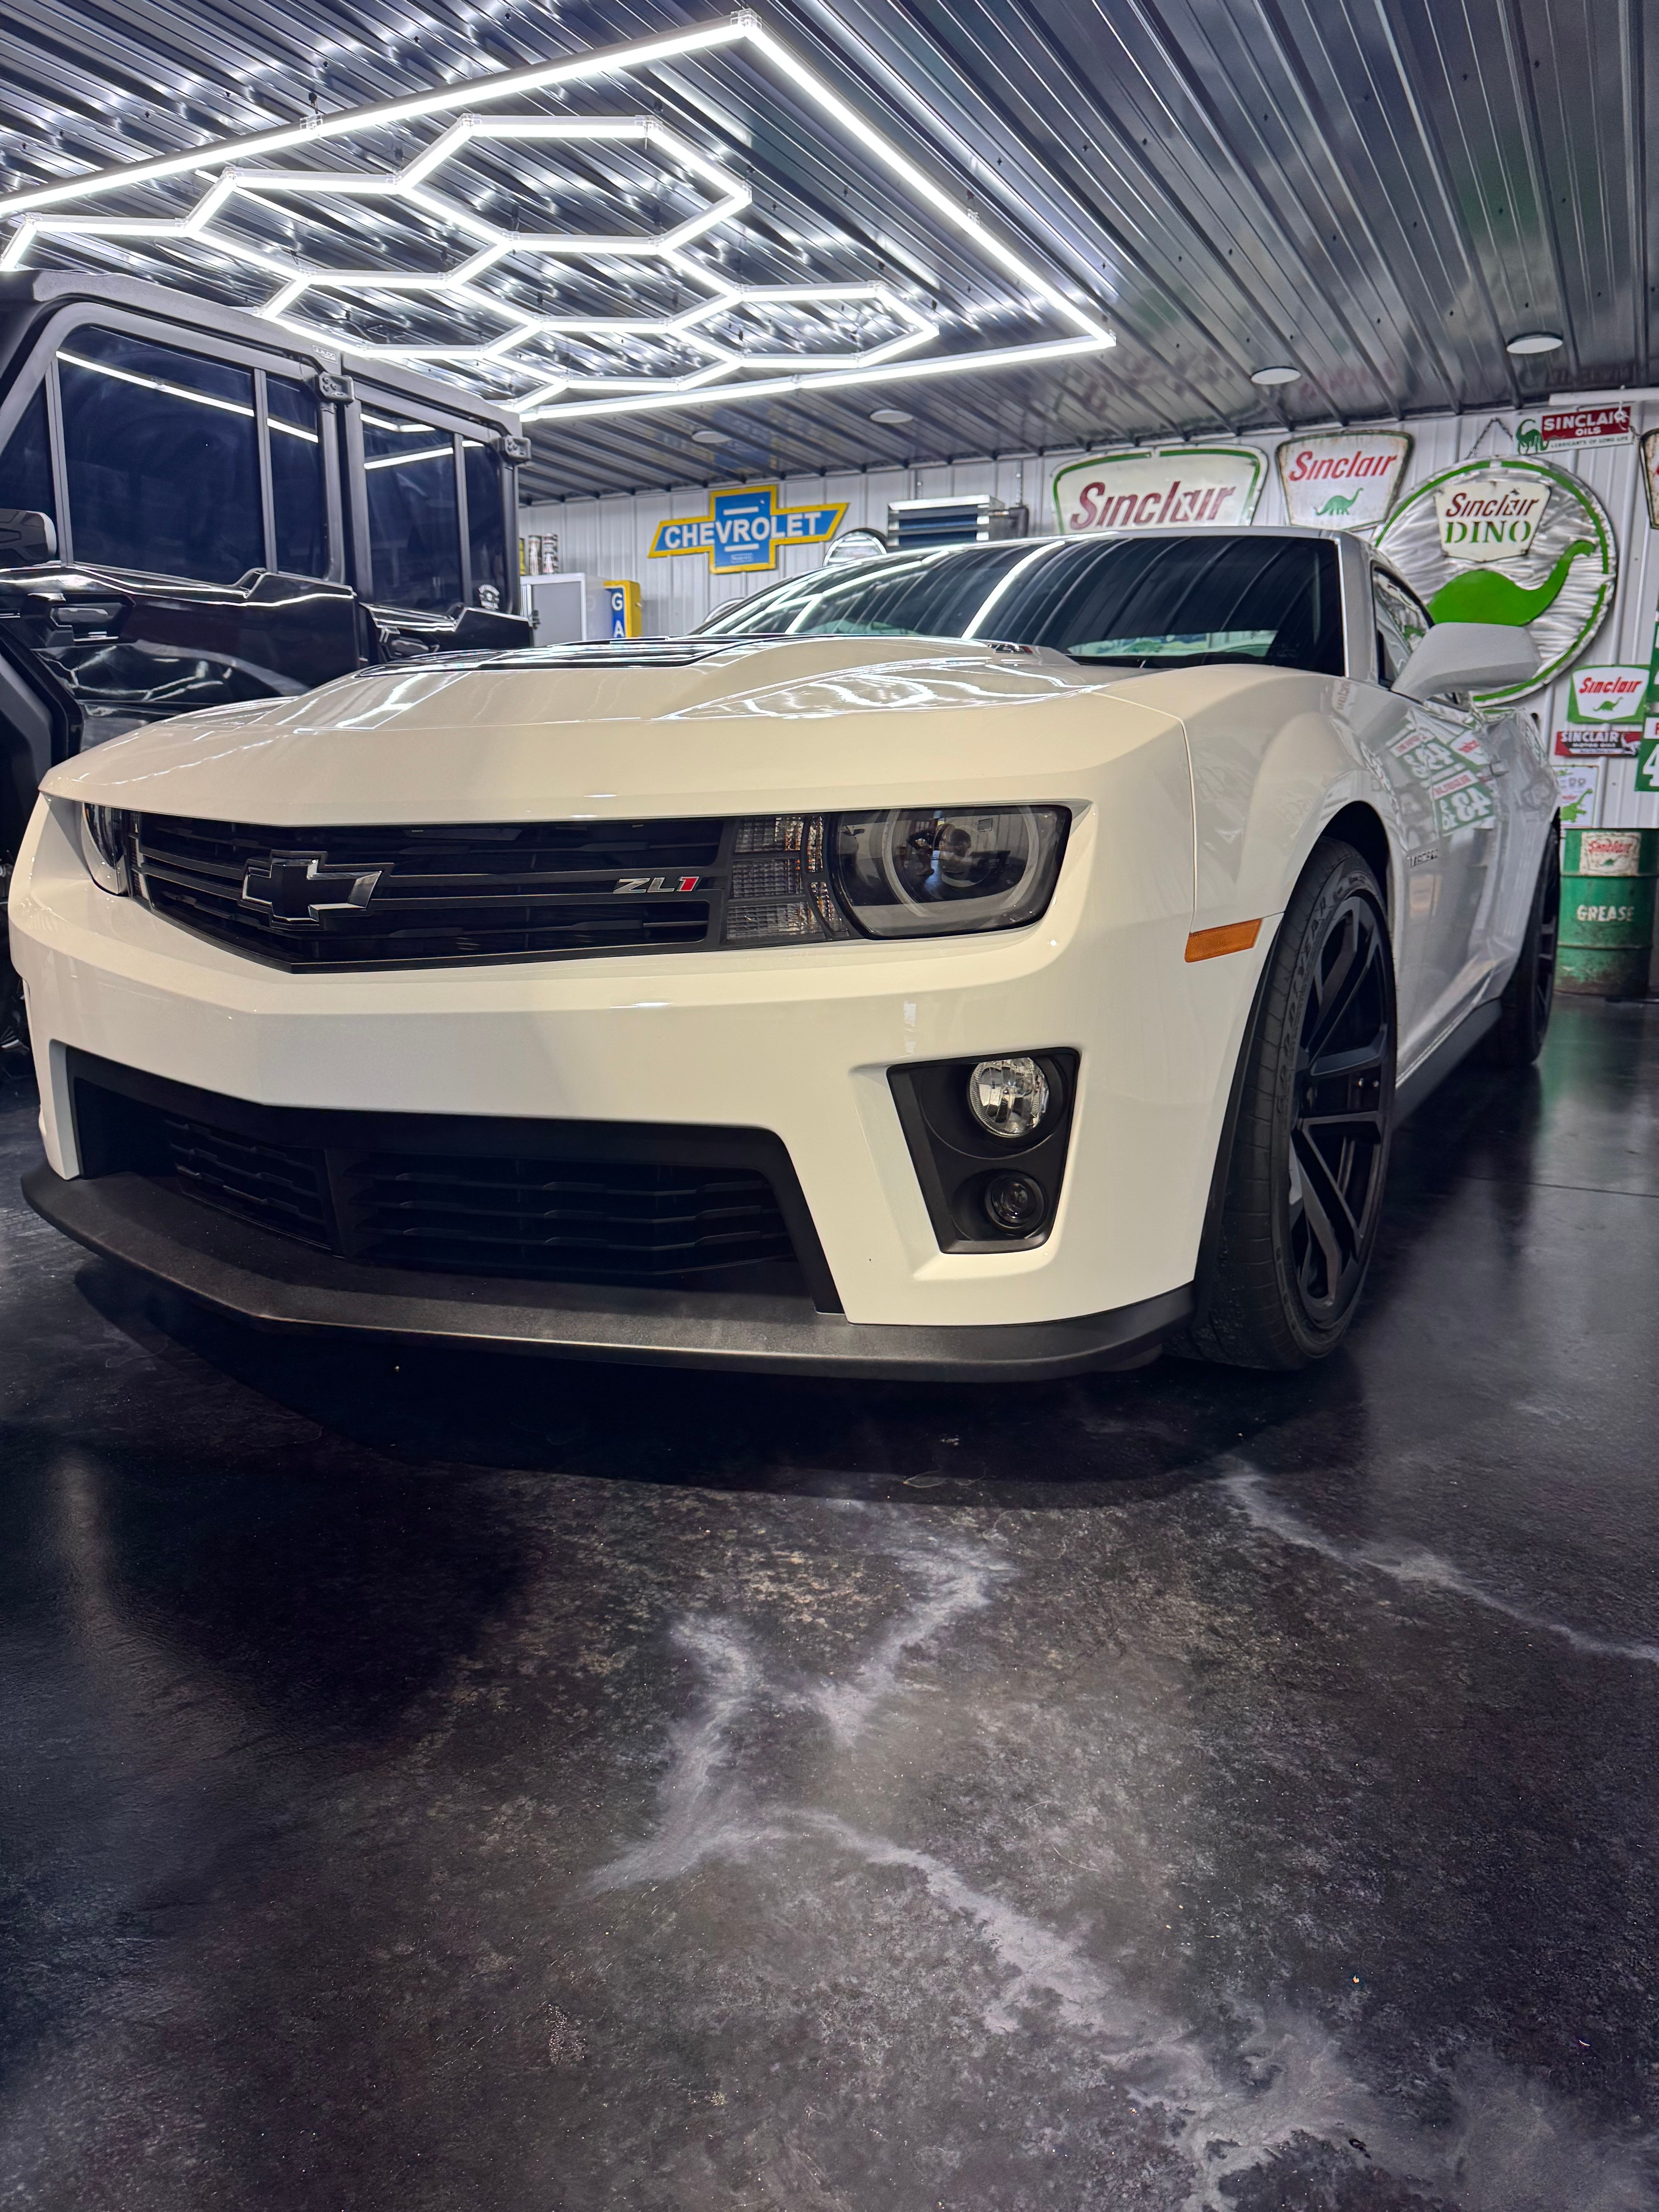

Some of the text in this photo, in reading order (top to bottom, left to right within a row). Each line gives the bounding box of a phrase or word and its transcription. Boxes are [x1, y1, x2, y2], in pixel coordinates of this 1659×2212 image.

[1544, 411, 1629, 431] SINCLAIR
[1575, 426, 1602, 436] OILS
[1288, 451, 1397, 481] Sinclair
[1070, 481, 1237, 531] Sinclair
[1446, 493, 1540, 517] Sinclair
[664, 512, 821, 549] CHEVROLET
[1444, 520, 1532, 544] DINO
[1579, 677, 1643, 694] Sinclair
[1561, 731, 1620, 742] SINCLAIR
[613, 876, 699, 894] ZL1
[1577, 905, 1635, 922] GREASE
